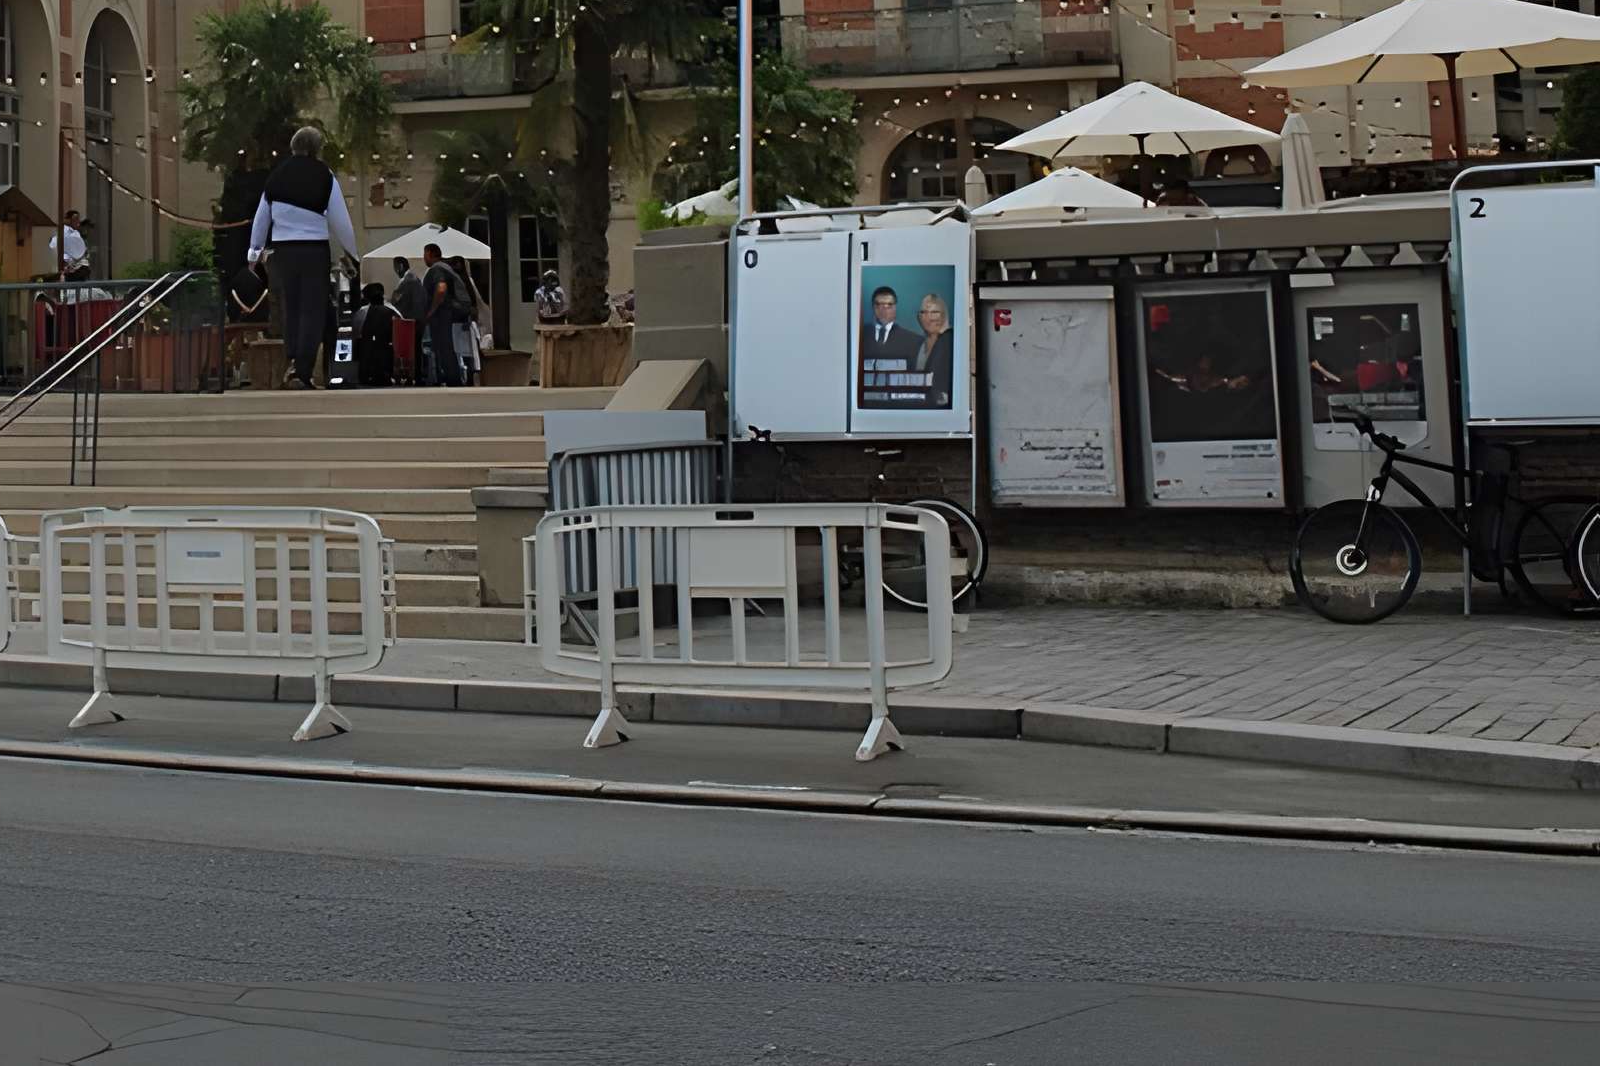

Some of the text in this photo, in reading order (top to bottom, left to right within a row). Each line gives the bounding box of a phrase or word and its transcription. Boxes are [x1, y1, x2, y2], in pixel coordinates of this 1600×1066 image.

[1470, 197, 1486, 218] 2
[744, 249, 758, 269] 0
[860, 241, 869, 262] 1
